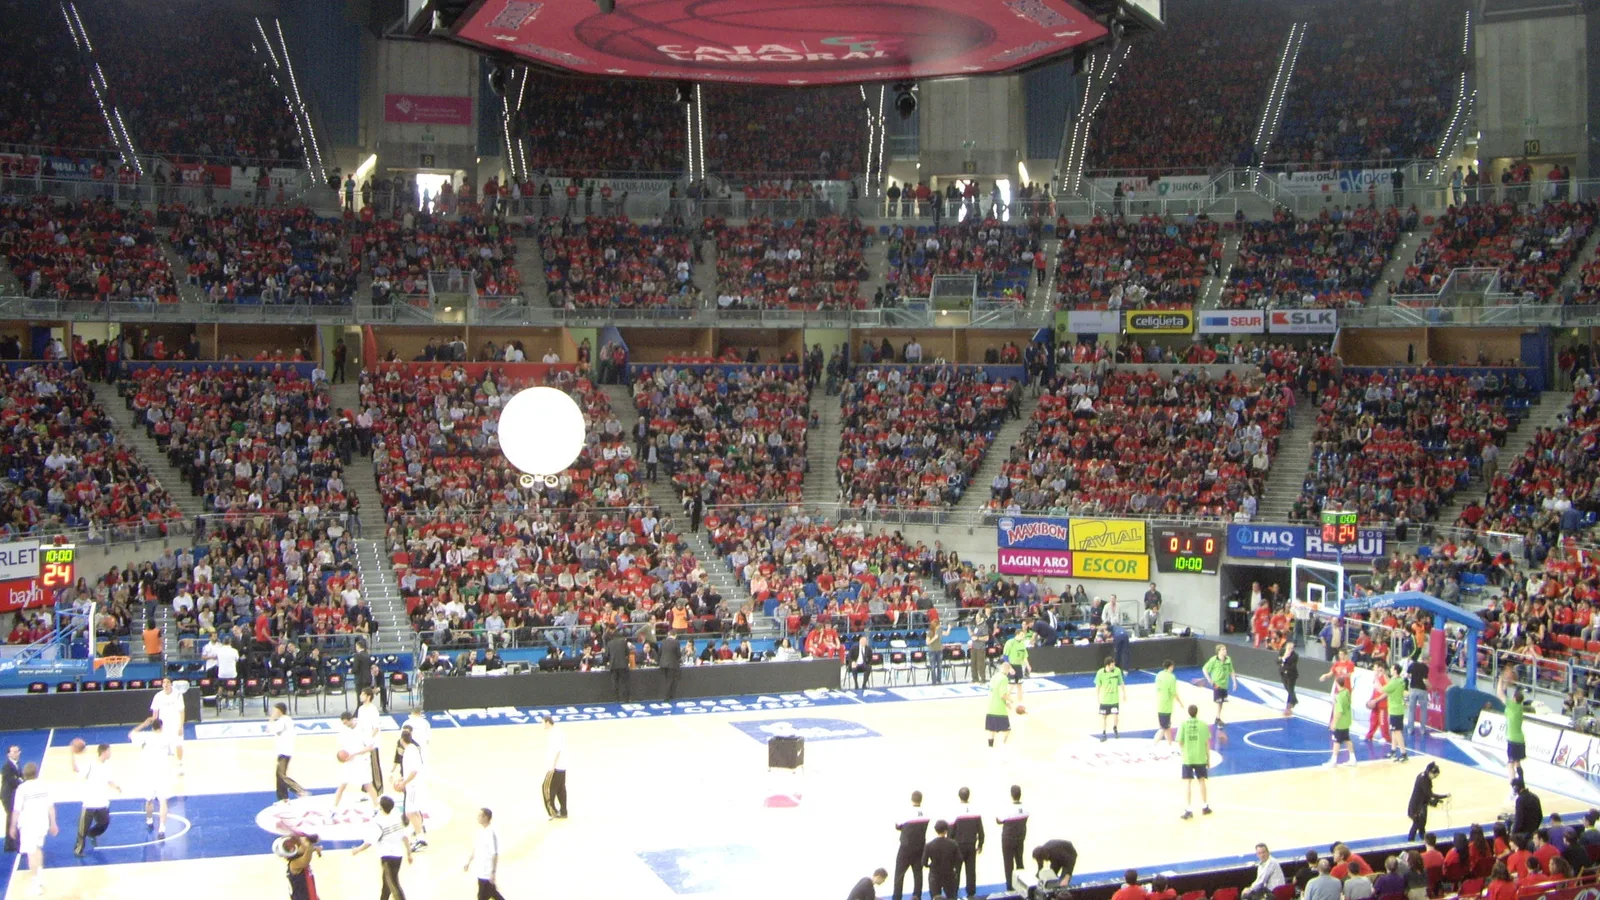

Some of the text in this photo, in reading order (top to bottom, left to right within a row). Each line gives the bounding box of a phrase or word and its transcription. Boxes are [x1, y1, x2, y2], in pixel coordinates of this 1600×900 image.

[1230, 316, 1262, 326] SEUR
[1291, 312, 1333, 324] SLK
[1007, 521, 1067, 545] MAXIBON
[1253, 531, 1295, 546] IMQ
[1338, 526, 1355, 542] 24
[1170, 537, 1214, 553] 0 1 0
[46, 550, 72, 562] 10:00
[1001, 555, 1068, 567] LAGUN ARO
[1175, 556, 1203, 570] 10:00
[1082, 557, 1138, 573] ESCOR
[43, 564, 70, 586] 24
